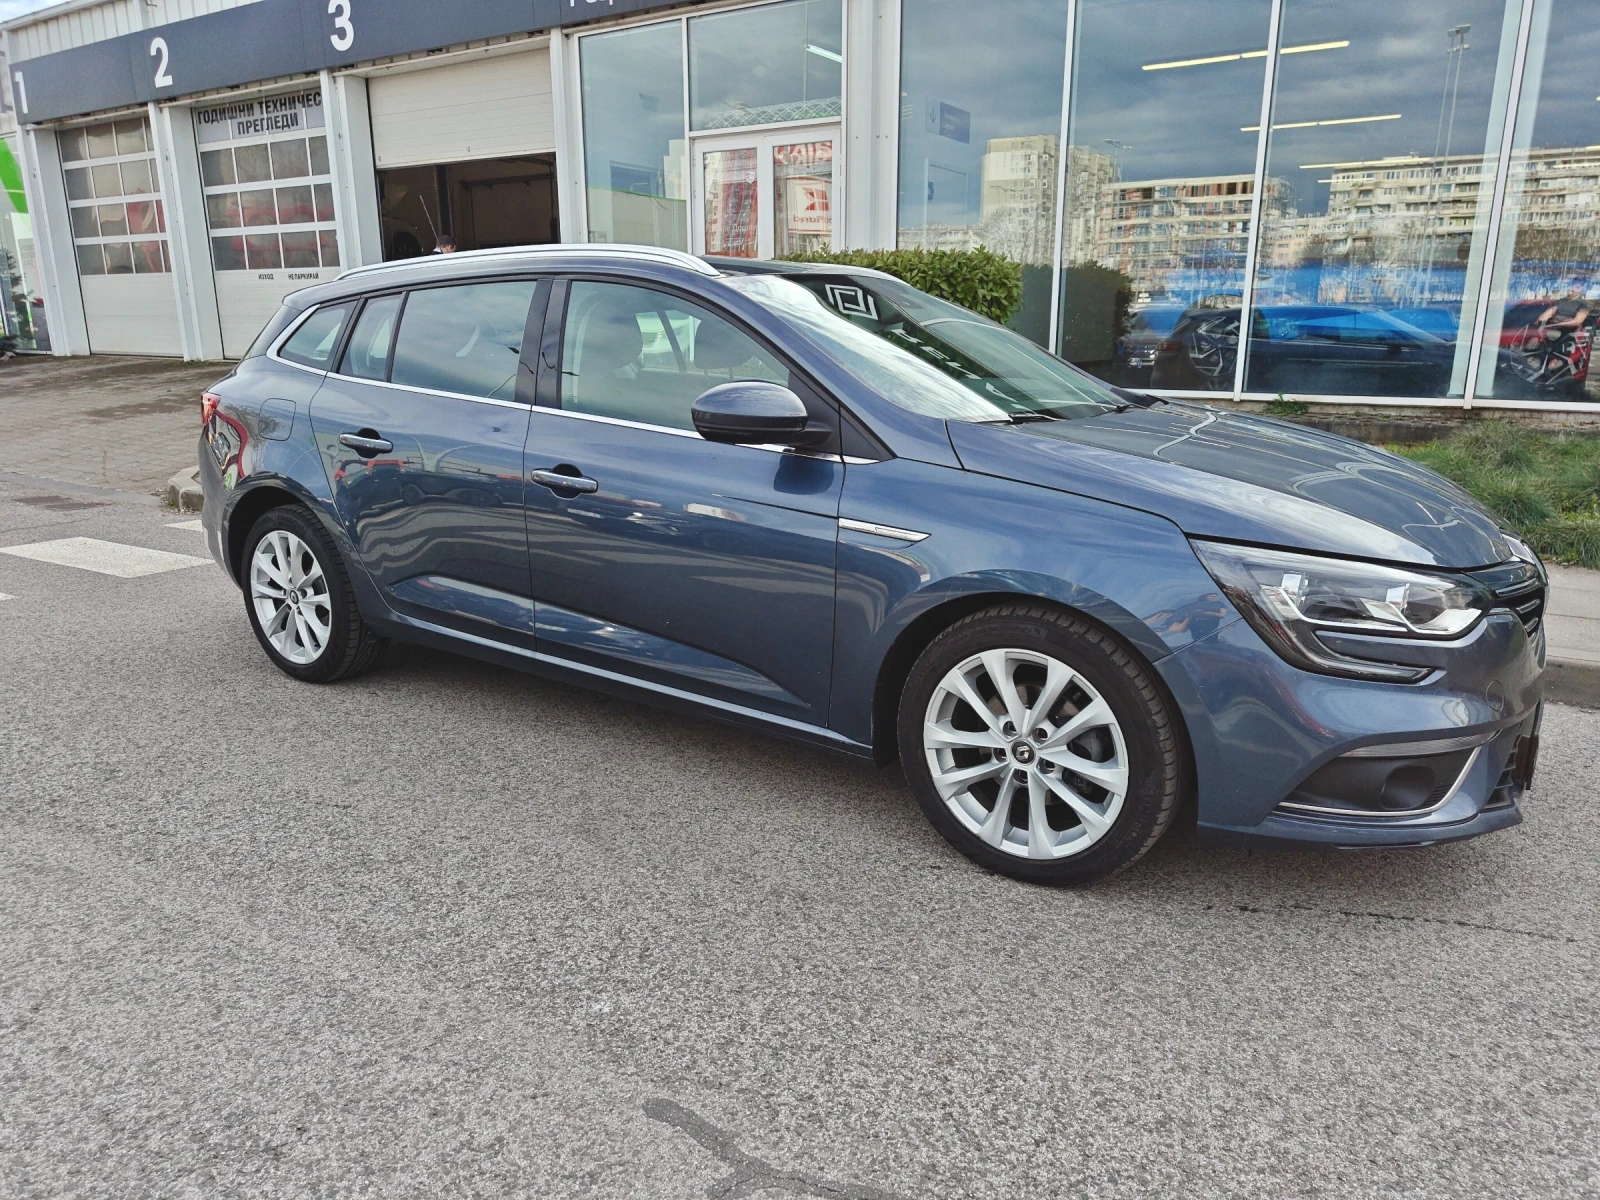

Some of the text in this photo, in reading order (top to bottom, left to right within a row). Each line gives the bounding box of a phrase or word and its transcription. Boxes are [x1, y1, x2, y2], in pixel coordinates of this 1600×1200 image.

[327, 0, 355, 51] 3
[150, 37, 173, 88] 2
[14, 71, 29, 114] 1
[197, 102, 255, 125] ГОДИШНИ
[237, 112, 299, 135] ПРЕГЛЕДИ
[988, 625, 1032, 635] Technology
